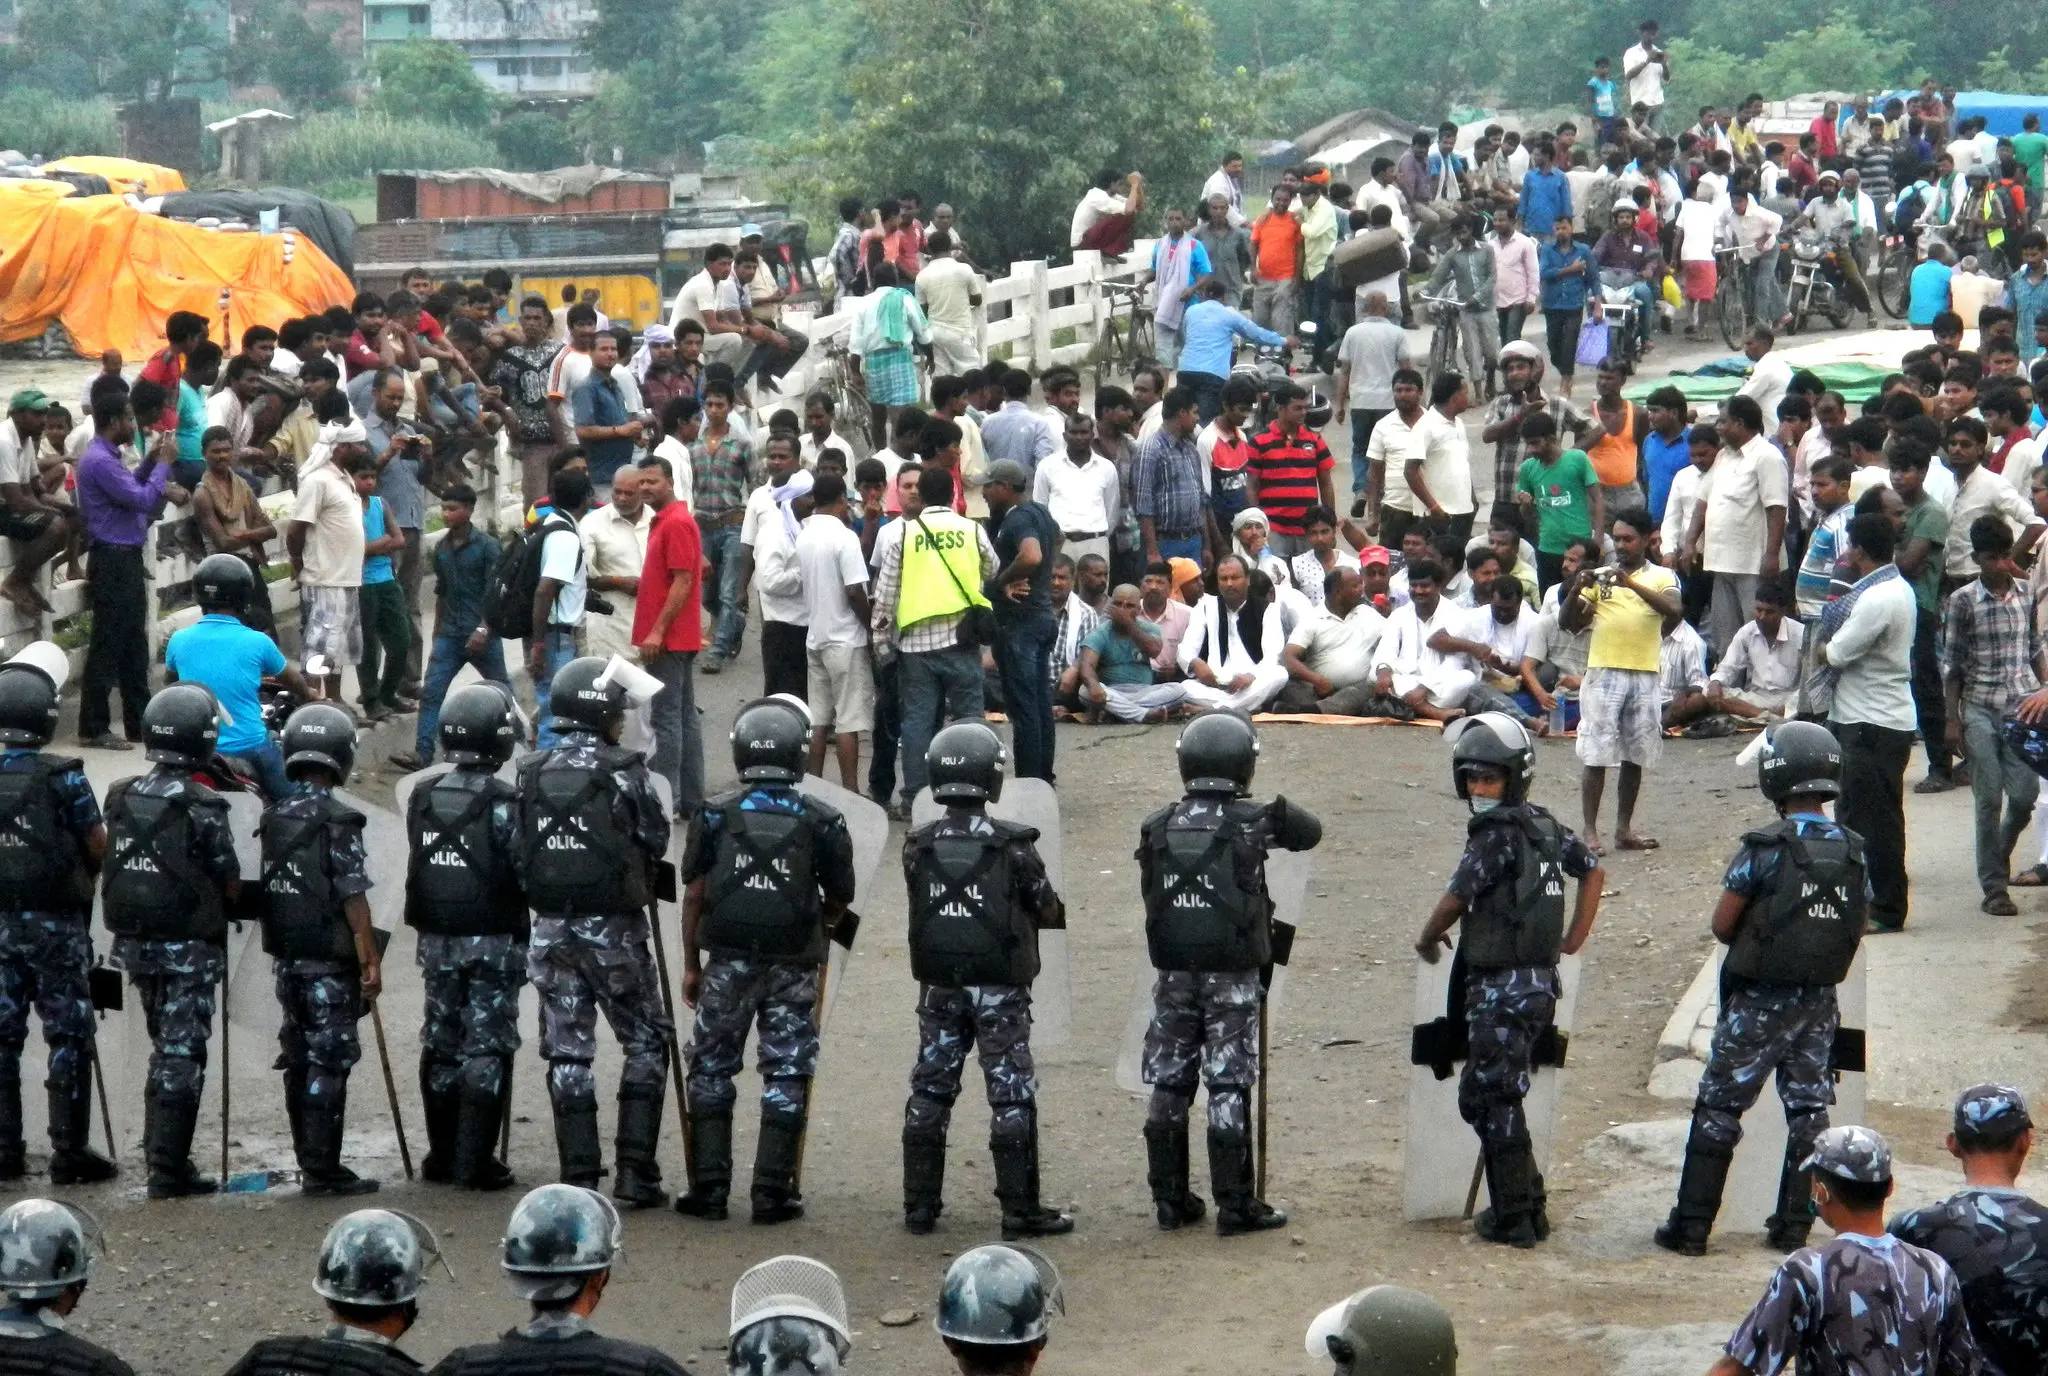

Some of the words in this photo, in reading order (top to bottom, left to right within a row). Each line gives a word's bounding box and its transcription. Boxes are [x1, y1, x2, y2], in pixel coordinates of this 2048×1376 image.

[578, 690, 608, 701] NEPAL
[151, 725, 174, 735] POLICE
[300, 725, 326, 734] POLICE
